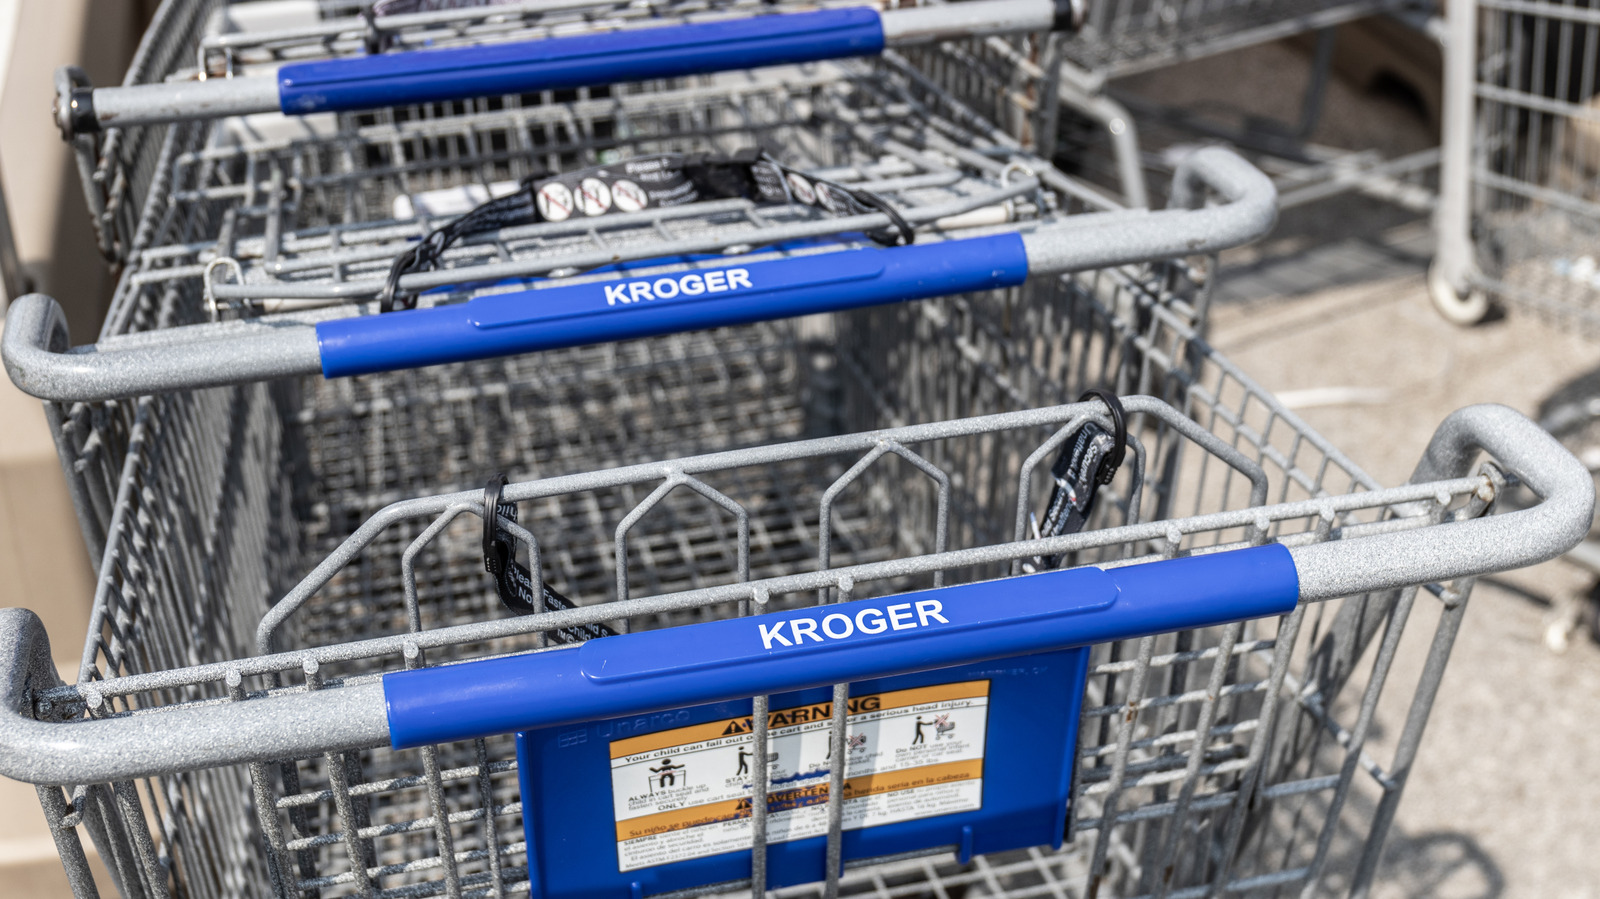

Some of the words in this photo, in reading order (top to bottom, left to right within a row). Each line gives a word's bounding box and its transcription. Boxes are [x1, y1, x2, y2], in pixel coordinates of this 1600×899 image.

[604, 268, 753, 306] KROGER
[758, 599, 950, 650] KROGER
[597, 711, 690, 738] Unarco
[742, 697, 881, 733] WARNNG
[625, 754, 650, 763] Your
[653, 748, 680, 757] child
[803, 722, 823, 730] and
[869, 708, 911, 718] serious
[912, 703, 938, 712] head
[941, 698, 973, 710] injury.
[936, 771, 970, 782] cabeza
[628, 791, 666, 801] ALWAYS
[657, 802, 685, 810] ONLY
[623, 836, 657, 845] SIEMPRE
